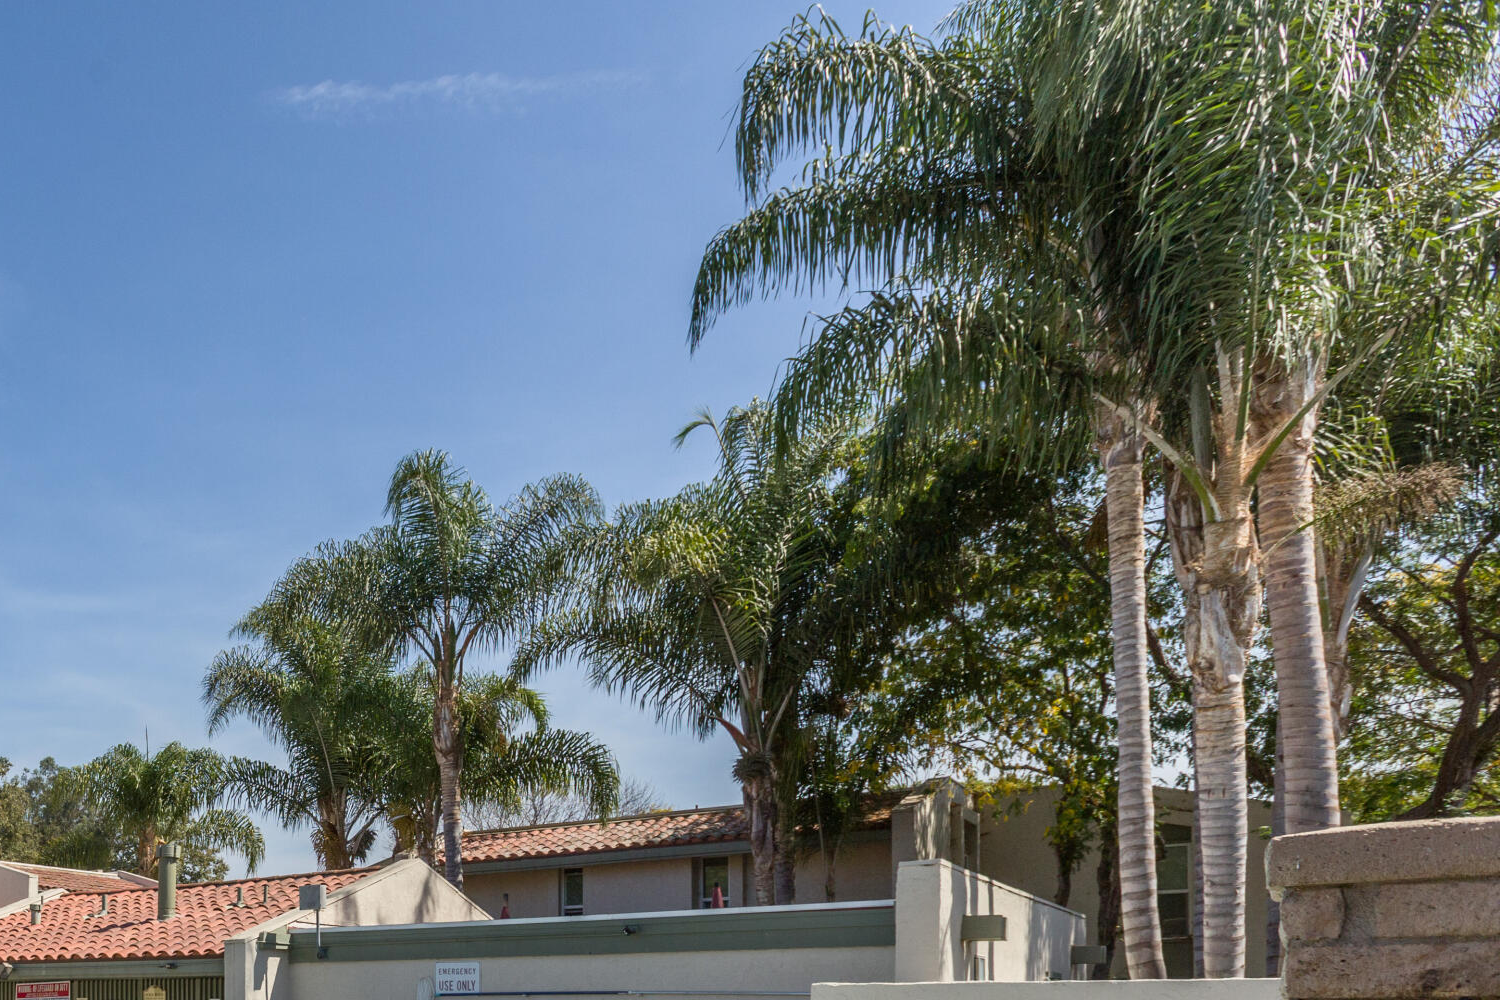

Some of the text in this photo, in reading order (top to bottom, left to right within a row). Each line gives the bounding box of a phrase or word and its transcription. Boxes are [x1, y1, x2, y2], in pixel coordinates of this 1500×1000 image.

[438, 967, 477, 976] EMERGENCY
[60, 983, 69, 991] DUTY
[438, 980, 476, 992] USE ONLY
